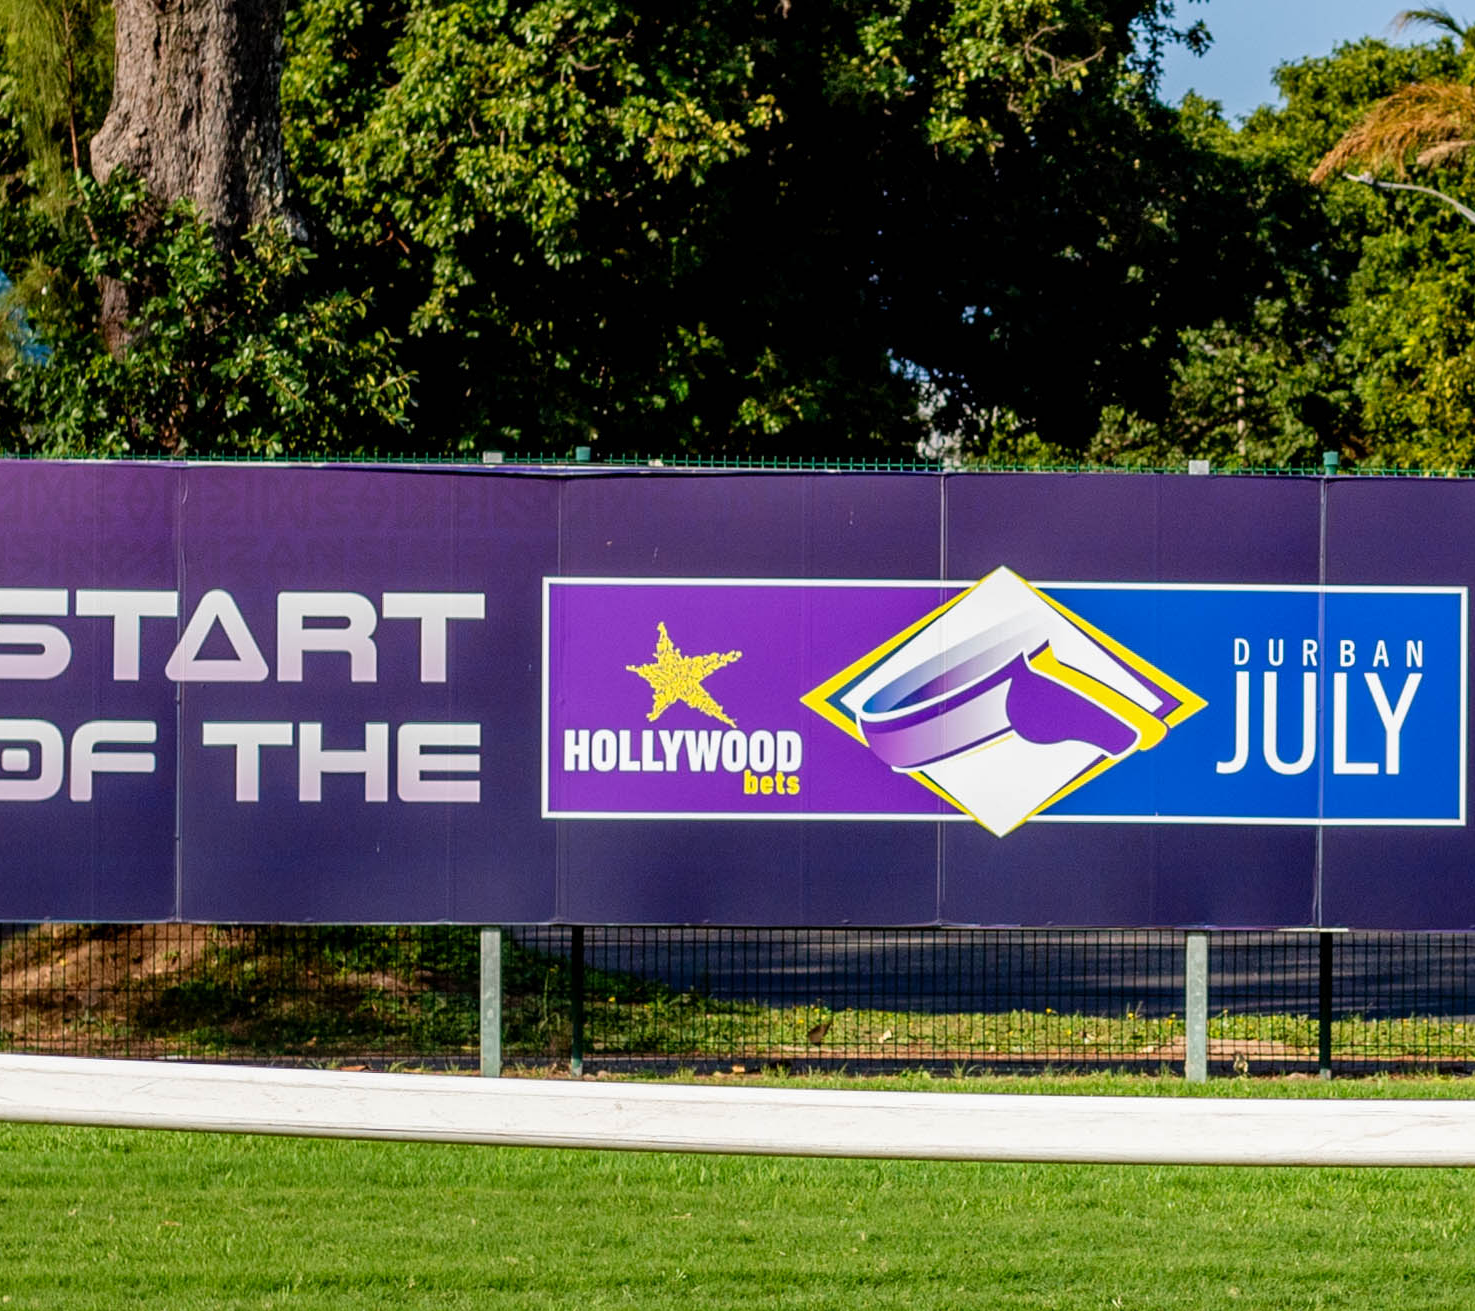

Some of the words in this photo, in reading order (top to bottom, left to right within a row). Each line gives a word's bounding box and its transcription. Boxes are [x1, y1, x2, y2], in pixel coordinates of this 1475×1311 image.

[1233, 638, 1426, 669] DURBAN
[1216, 670, 1423, 776] JULY
[202, 722, 481, 803] THE
[563, 729, 803, 774] HOLLYWOOD
[743, 767, 802, 797] bets
